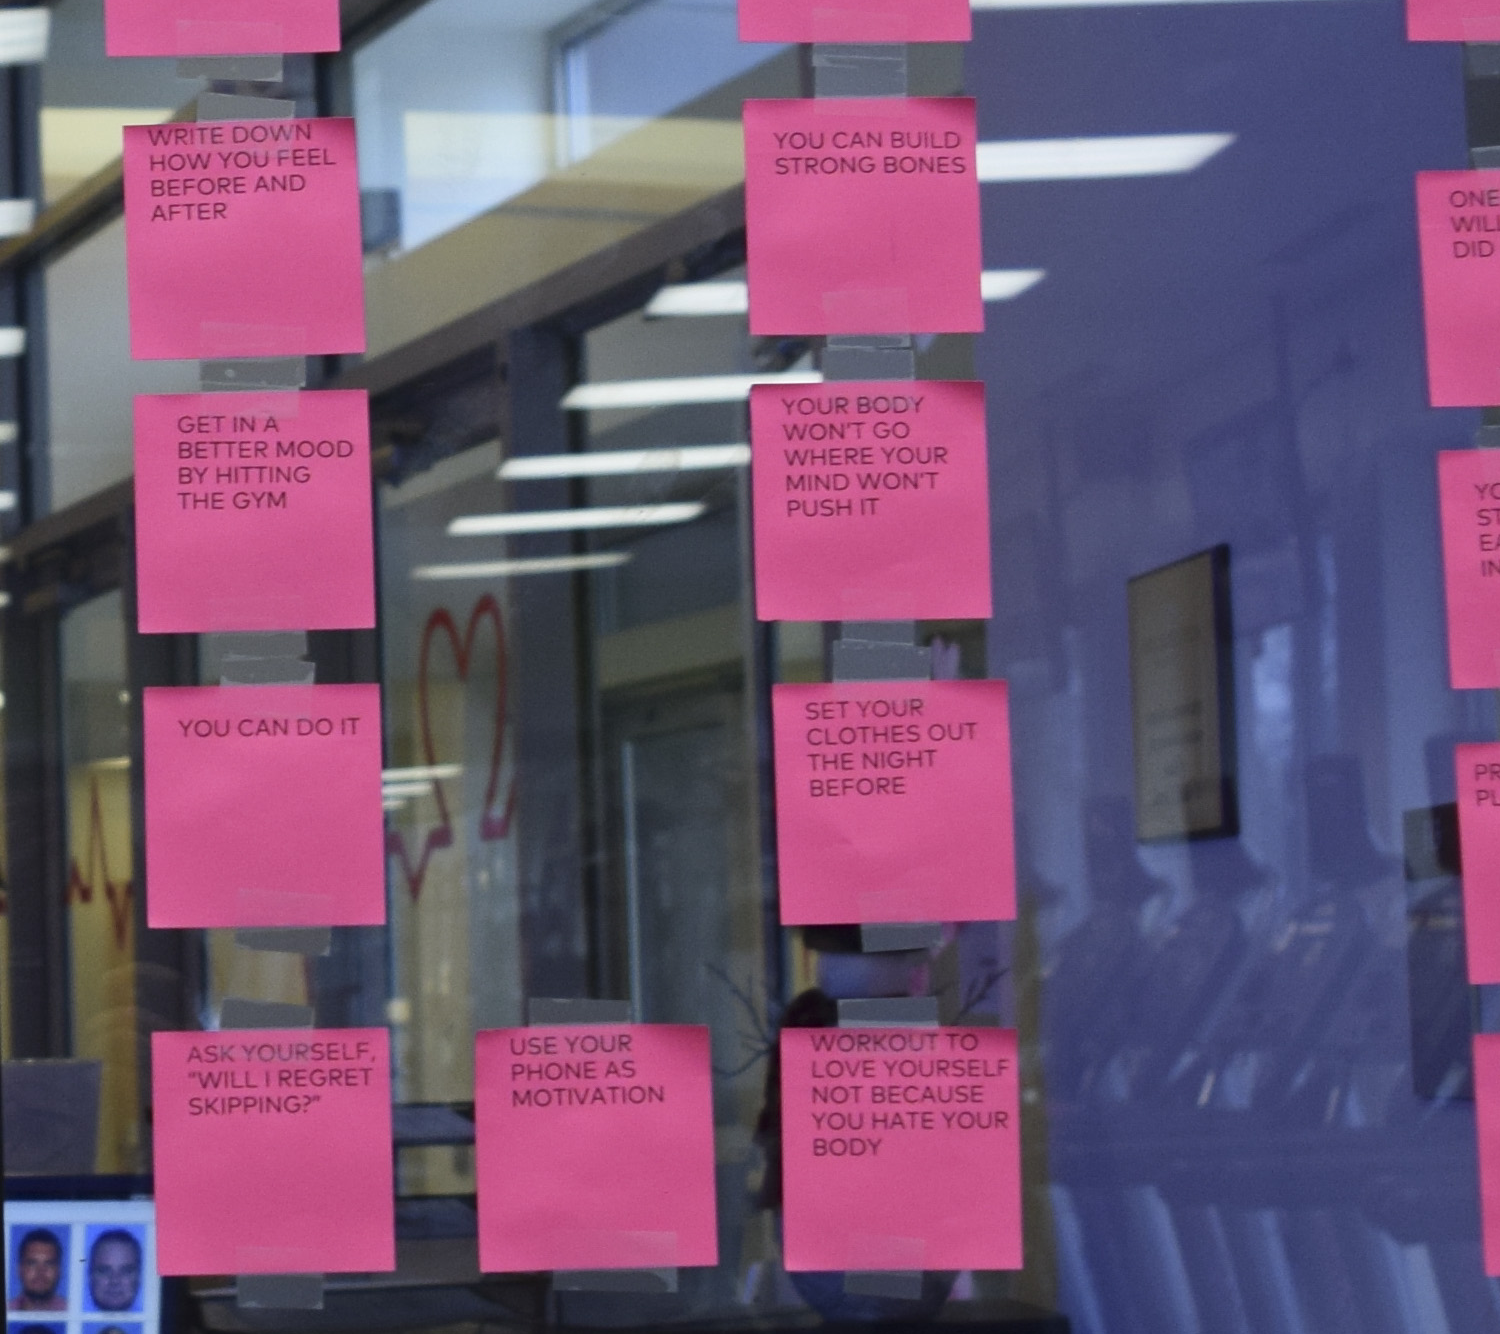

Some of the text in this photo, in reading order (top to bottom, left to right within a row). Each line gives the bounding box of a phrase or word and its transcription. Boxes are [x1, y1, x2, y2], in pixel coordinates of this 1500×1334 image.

[773, 130, 962, 151] YOU CAN BUILD
[774, 155, 967, 176] STRONG BONES
[177, 716, 361, 739] YOU CAN DO IT
[186, 1041, 376, 1064] ASK YOURSELF,
[264, 1070, 271, 1088] I
[277, 1067, 374, 1088] REGRET
